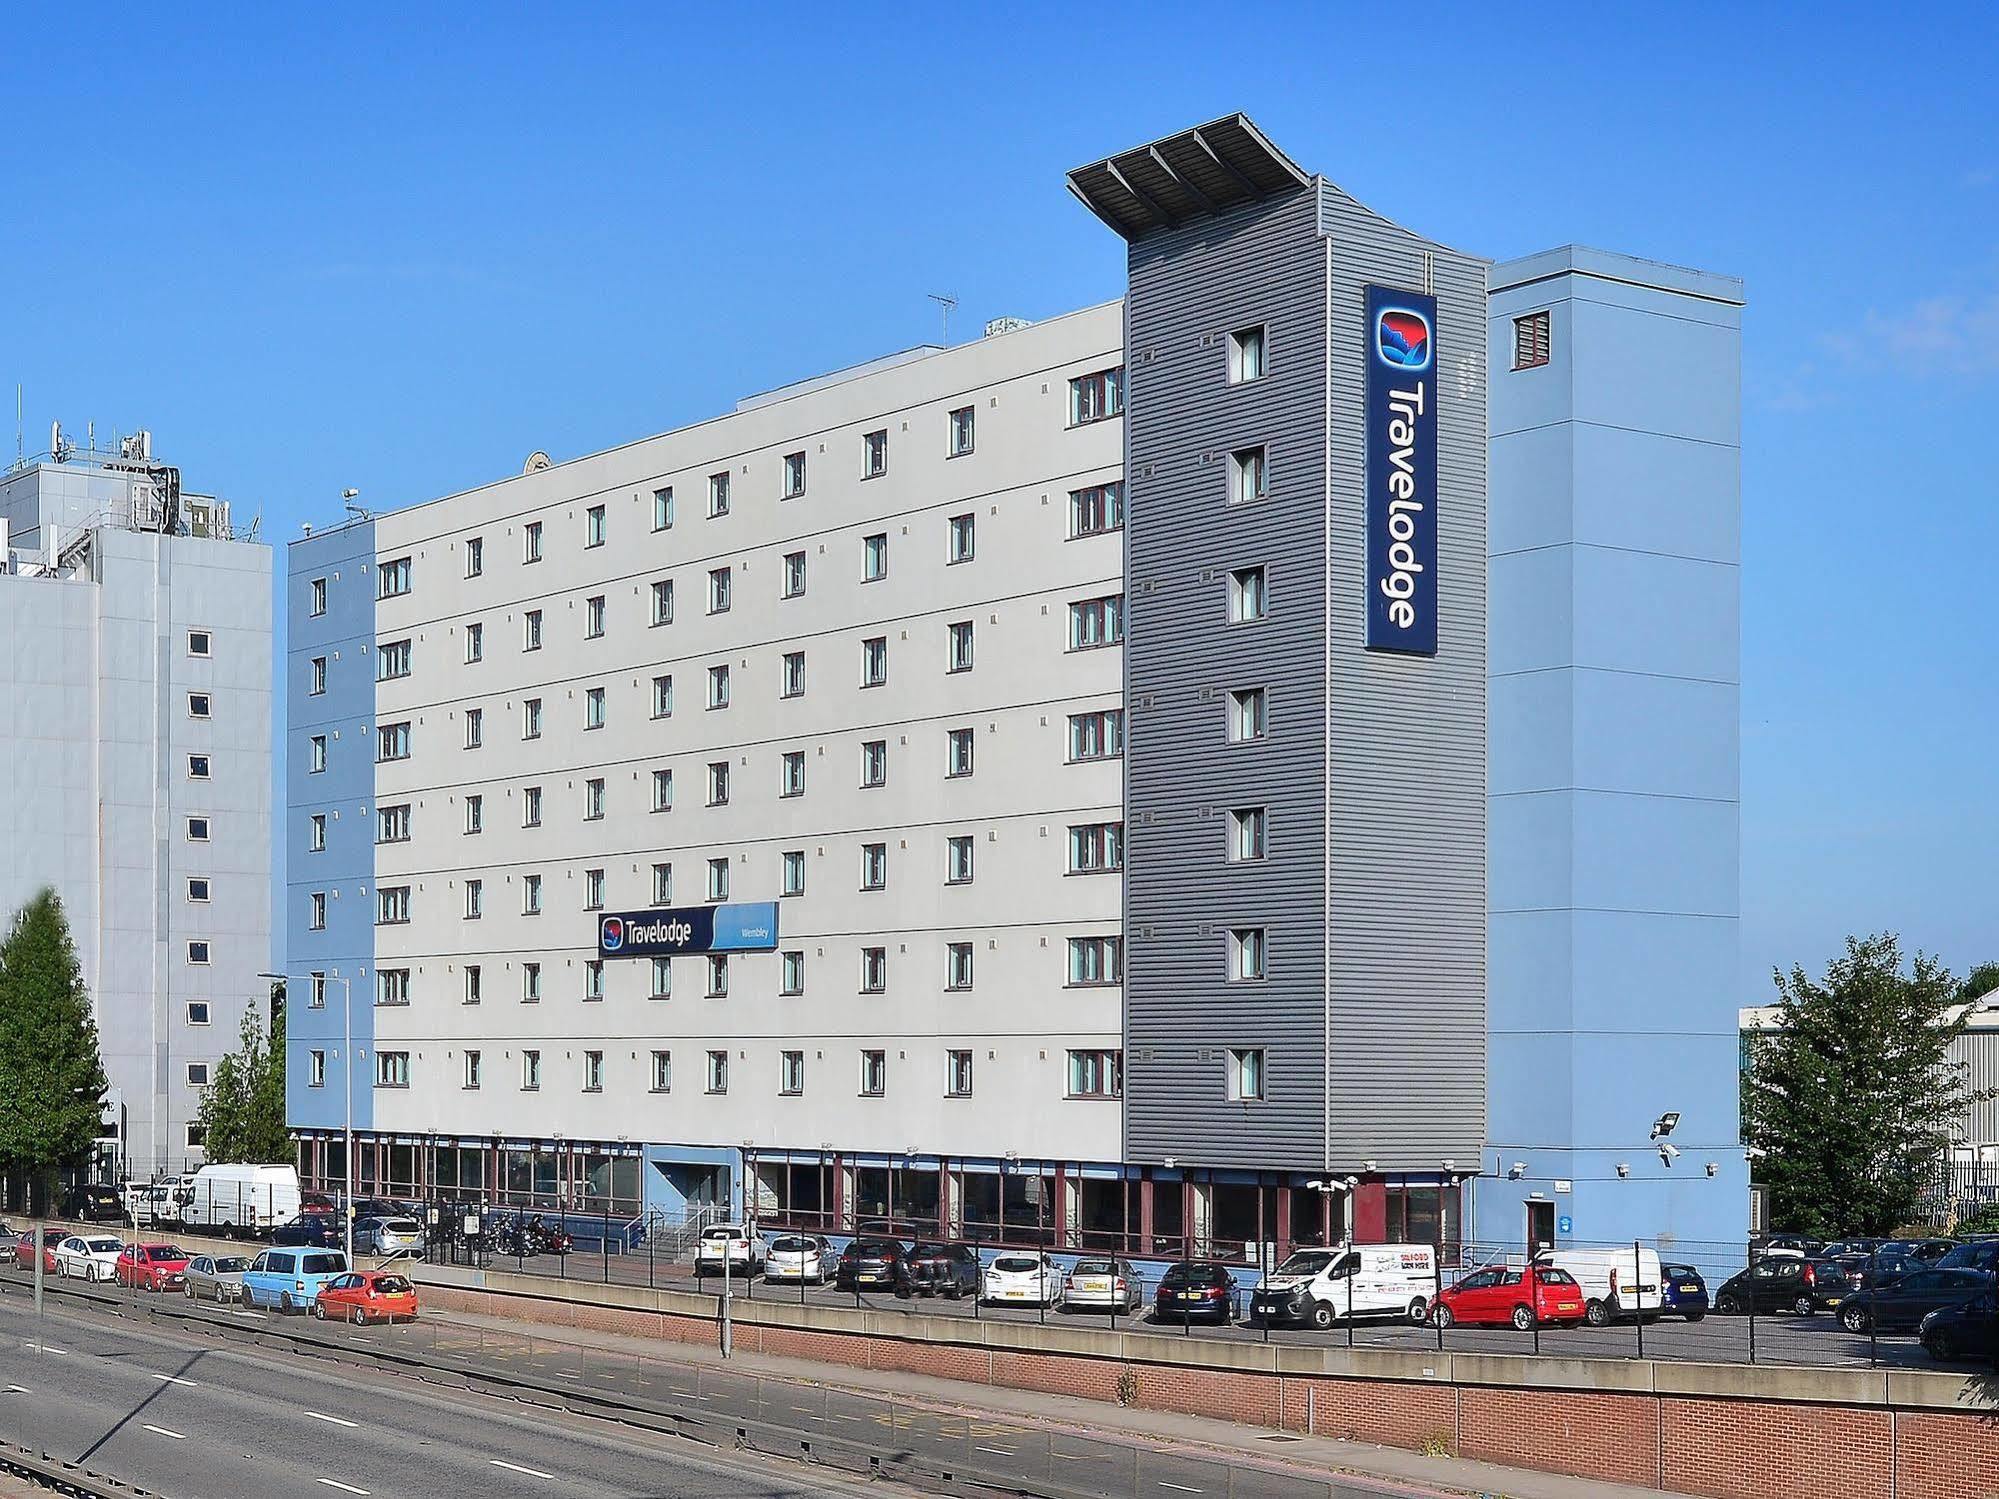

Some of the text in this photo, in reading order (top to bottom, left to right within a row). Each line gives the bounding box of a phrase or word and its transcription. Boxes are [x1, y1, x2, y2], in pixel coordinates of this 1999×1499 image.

[1381, 381, 1424, 629] Travelodge
[626, 918, 692, 947] Travelodge
[741, 927, 769, 939] Wembley
